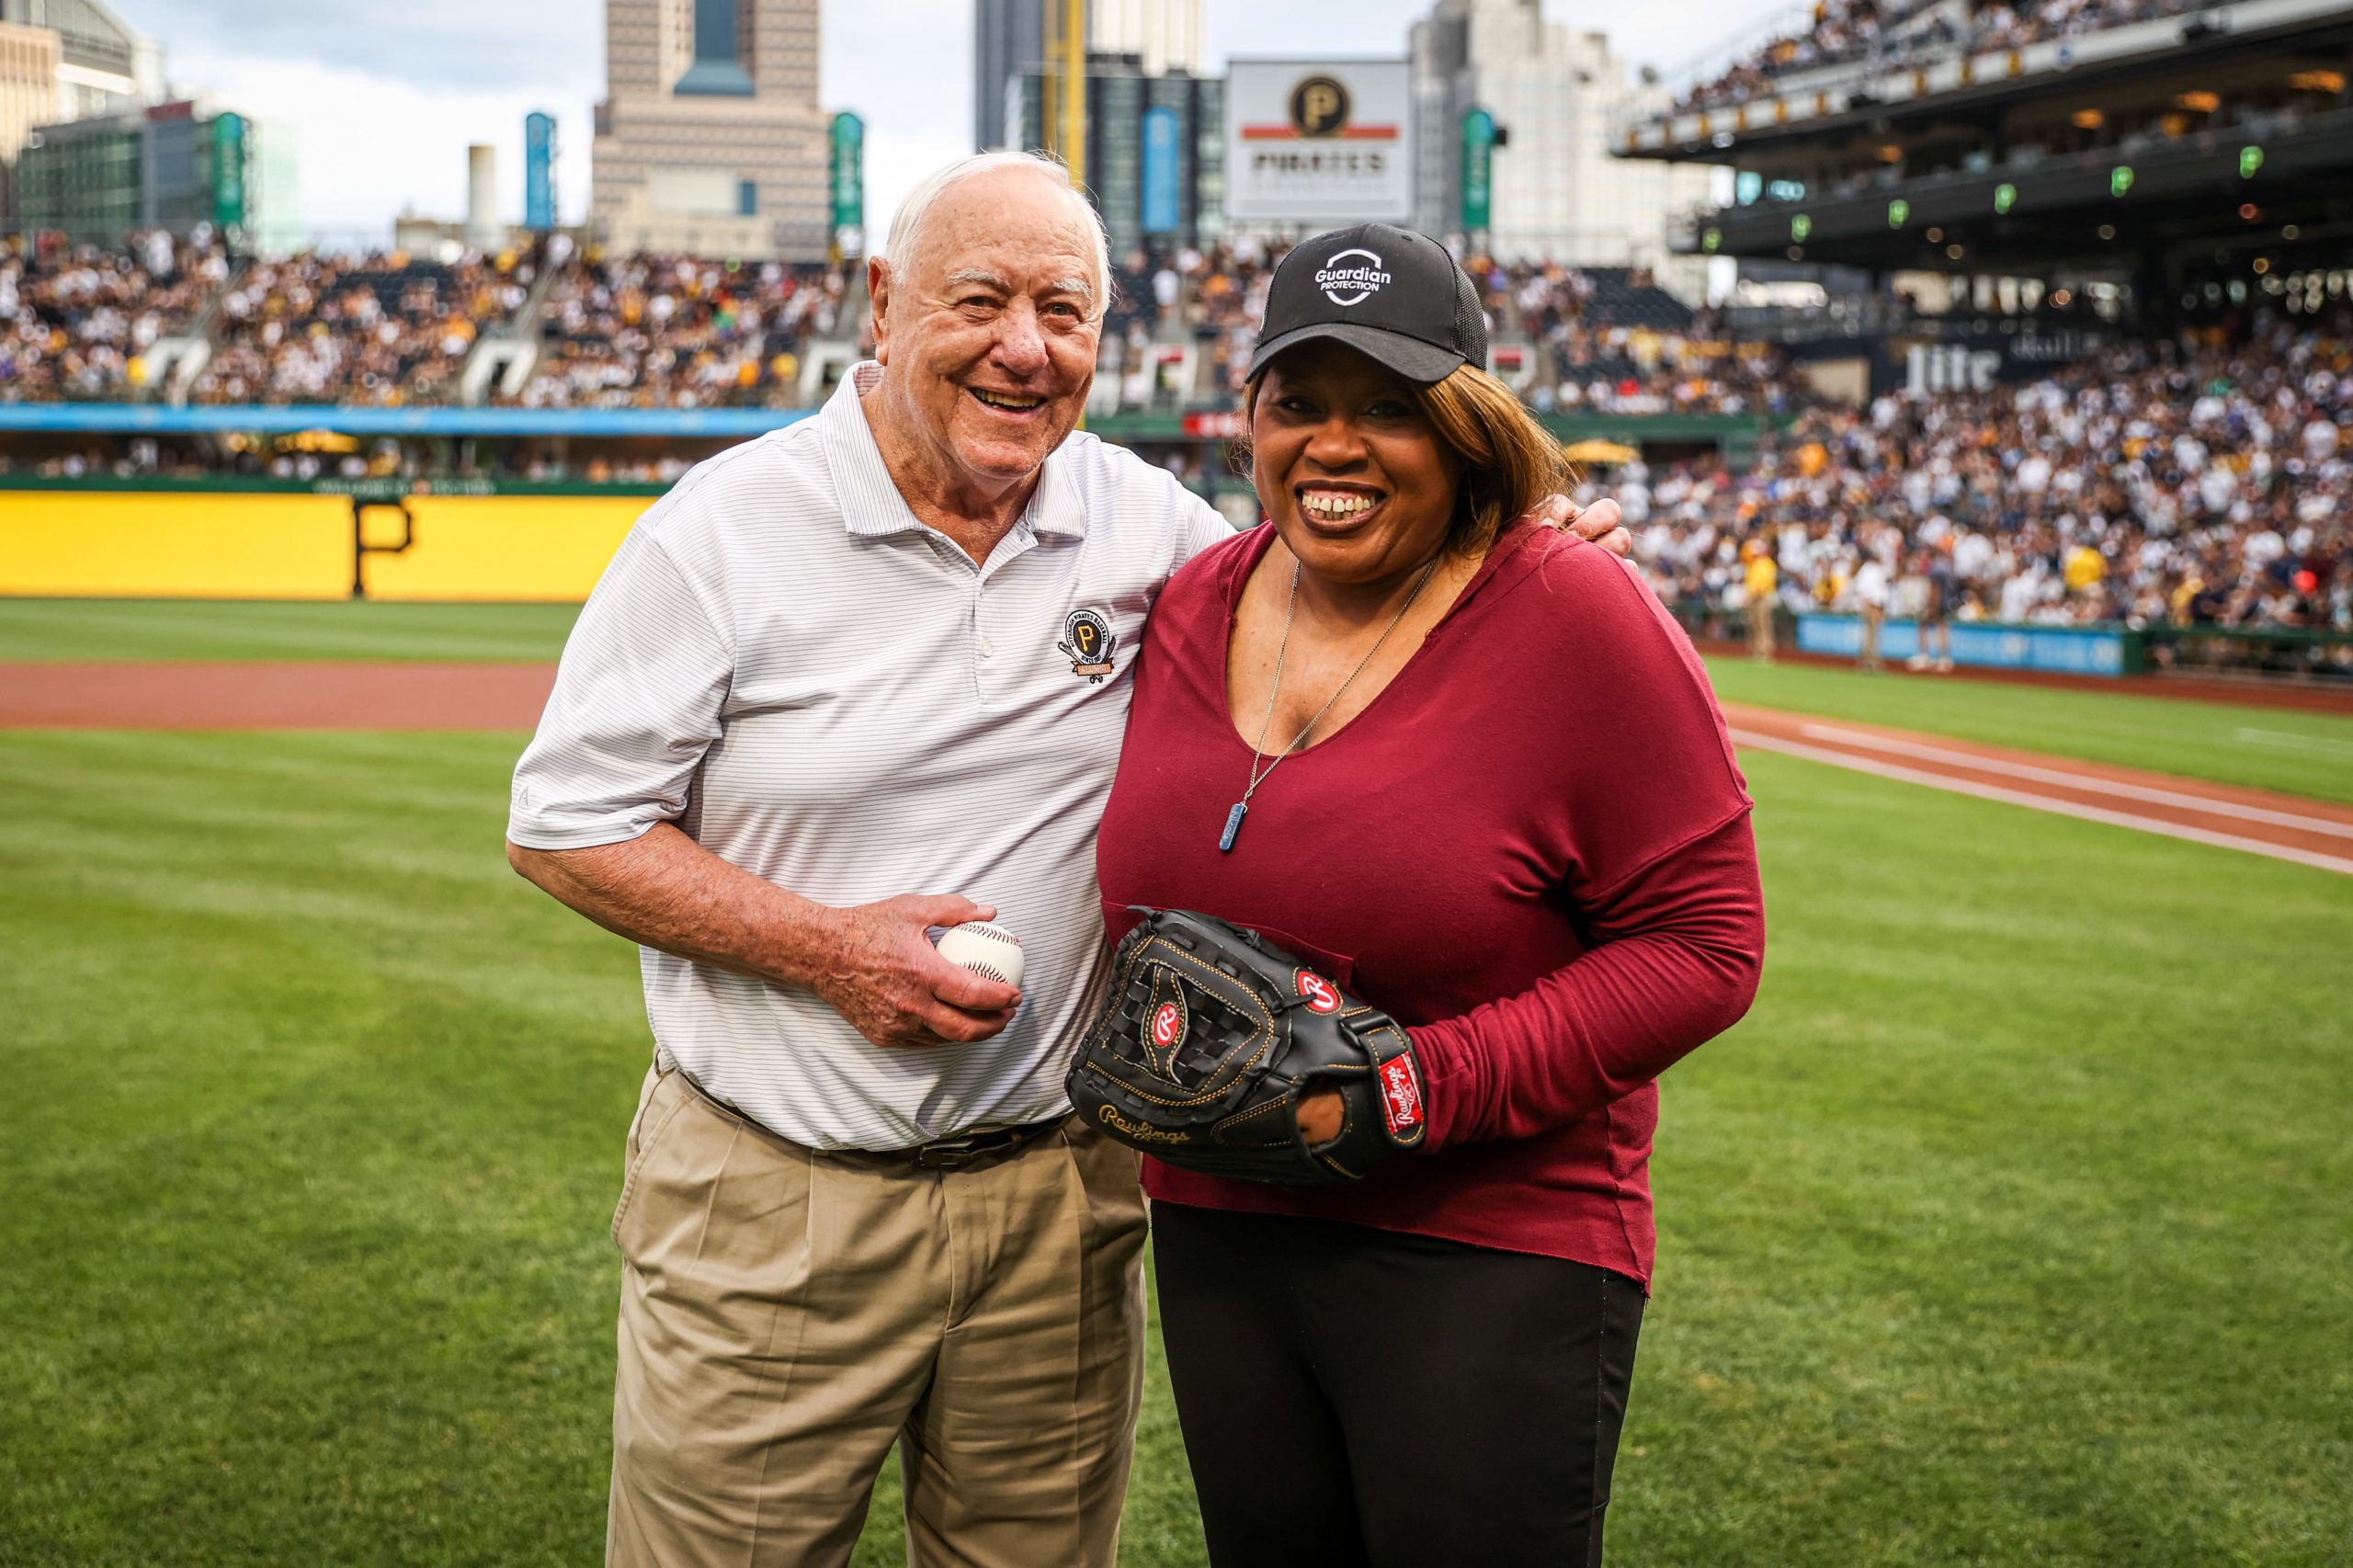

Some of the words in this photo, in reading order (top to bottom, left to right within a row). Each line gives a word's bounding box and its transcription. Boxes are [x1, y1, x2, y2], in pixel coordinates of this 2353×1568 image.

[1302, 84, 1340, 131] P
[1252, 151, 1385, 176] PIRATES
[1314, 267, 1392, 284] Guardian
[1320, 280, 1380, 292] PROTECTION
[353, 498, 412, 598] P
[1077, 624, 1095, 652] P
[1386, 1065, 1415, 1126] Rawlings
[1098, 1104, 1191, 1145] Rawlings
